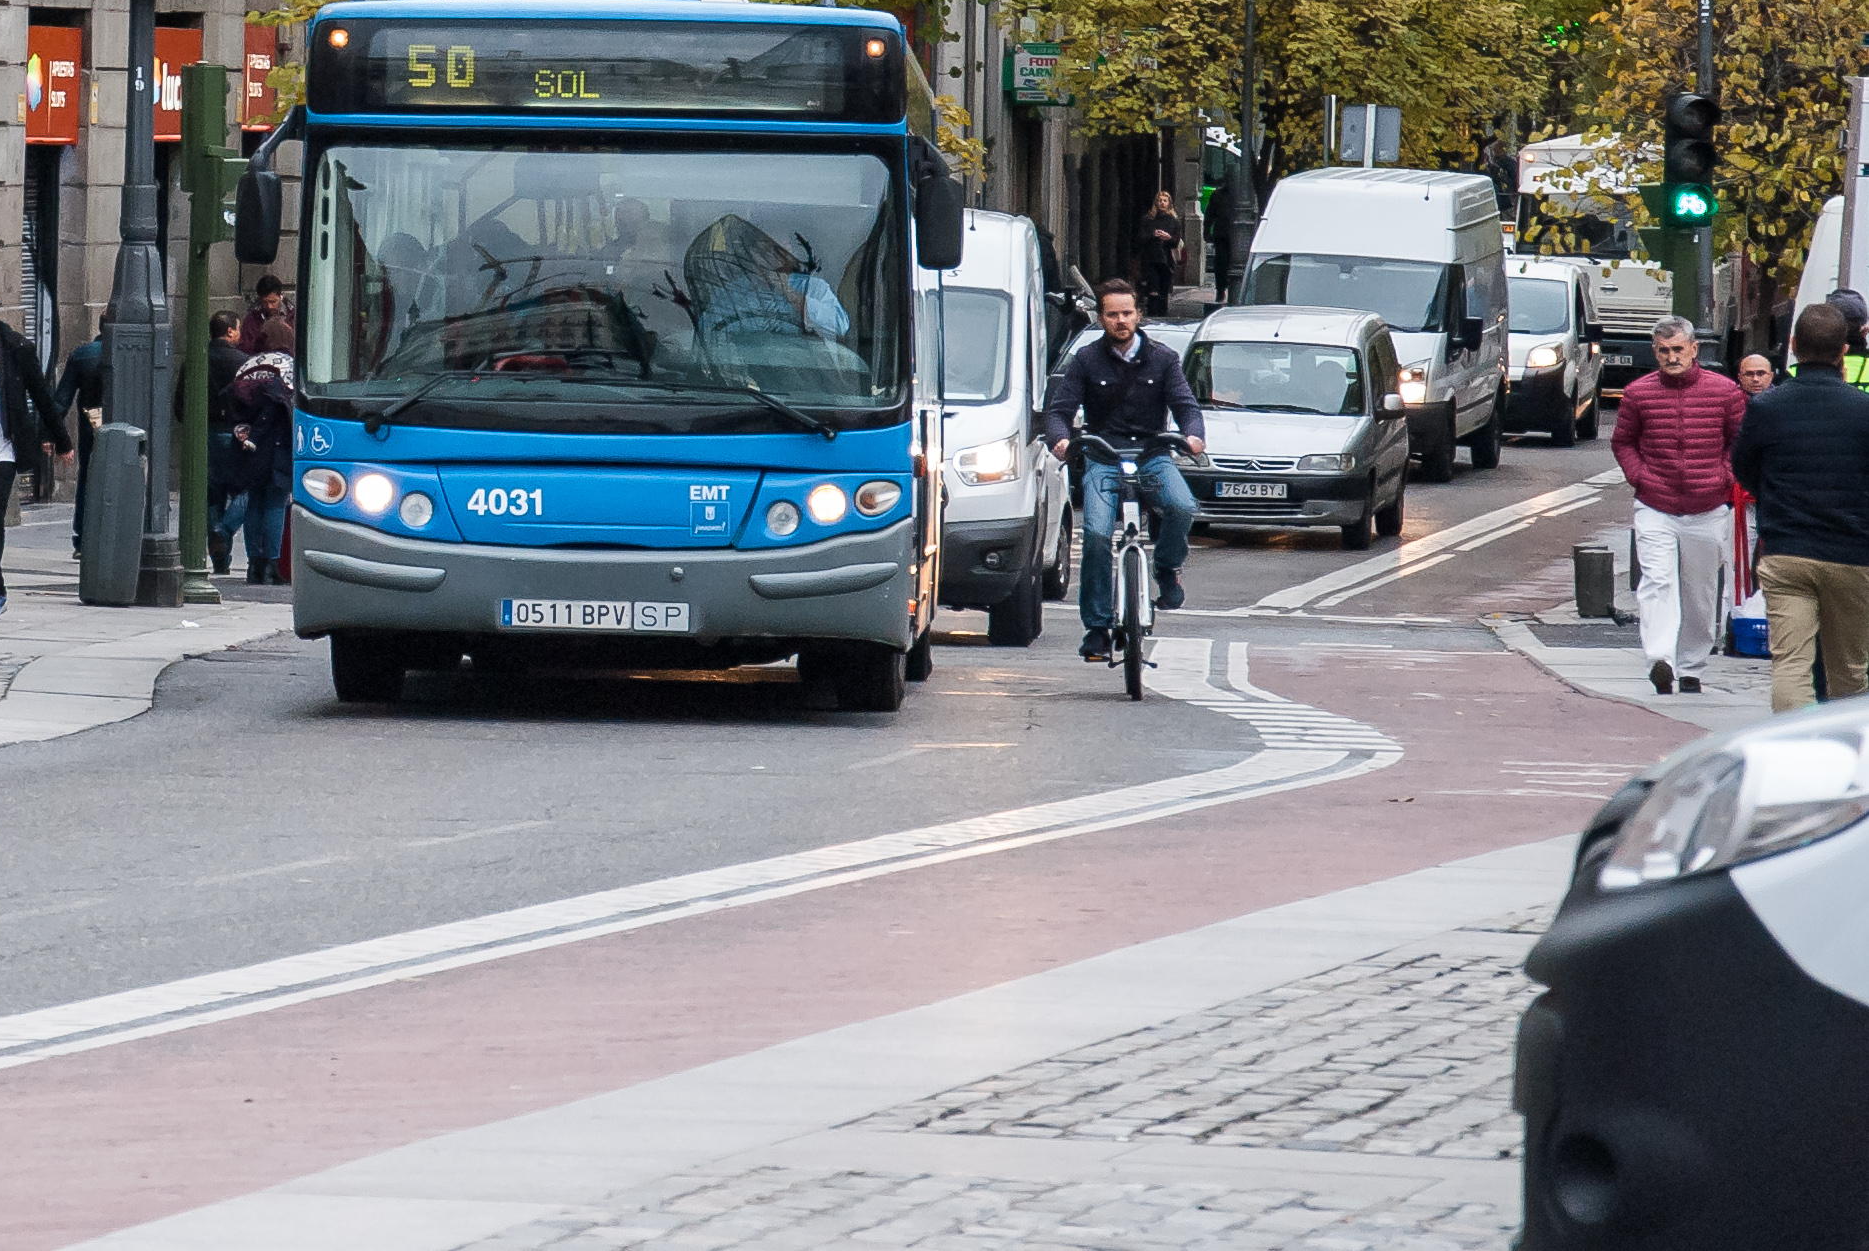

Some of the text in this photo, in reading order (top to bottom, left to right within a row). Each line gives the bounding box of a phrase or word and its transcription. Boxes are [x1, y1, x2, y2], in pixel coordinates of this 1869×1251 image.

[408, 44, 601, 98] 50 SOL
[1020, 67, 1052, 77] CARN
[1029, 58, 1058, 66] FOTO
[161, 62, 183, 111] luc
[467, 485, 731, 516] 4031 EMT
[1224, 483, 1285, 497] 7649 BYJ
[516, 603, 682, 627] 0511 BPV SP
